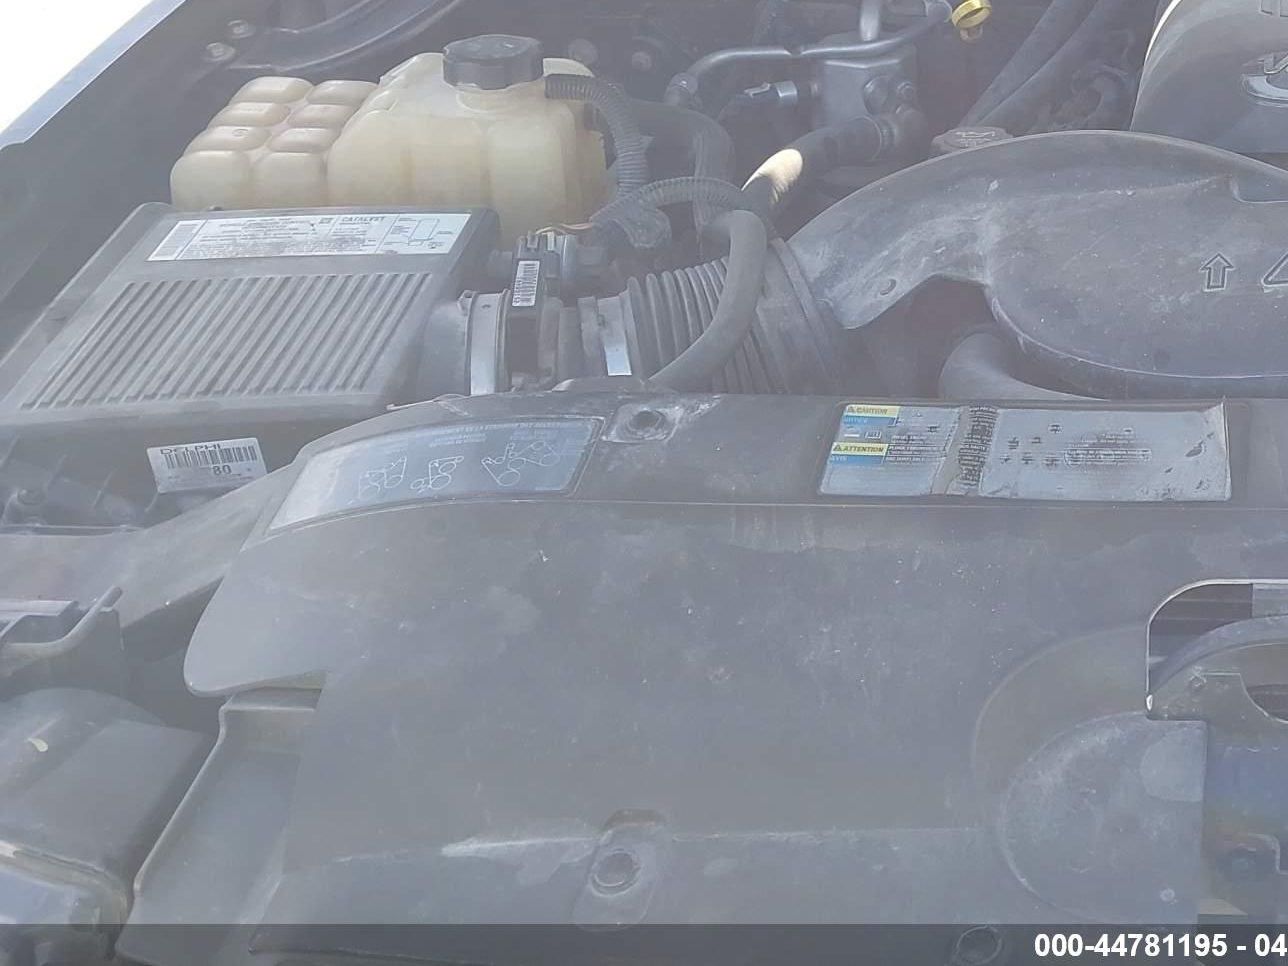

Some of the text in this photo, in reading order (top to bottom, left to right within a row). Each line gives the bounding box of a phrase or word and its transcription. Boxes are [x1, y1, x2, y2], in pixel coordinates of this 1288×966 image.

[855, 407, 888, 415] CAUTION
[843, 445, 884, 453] ATTENTION
[211, 464, 233, 476] 80
